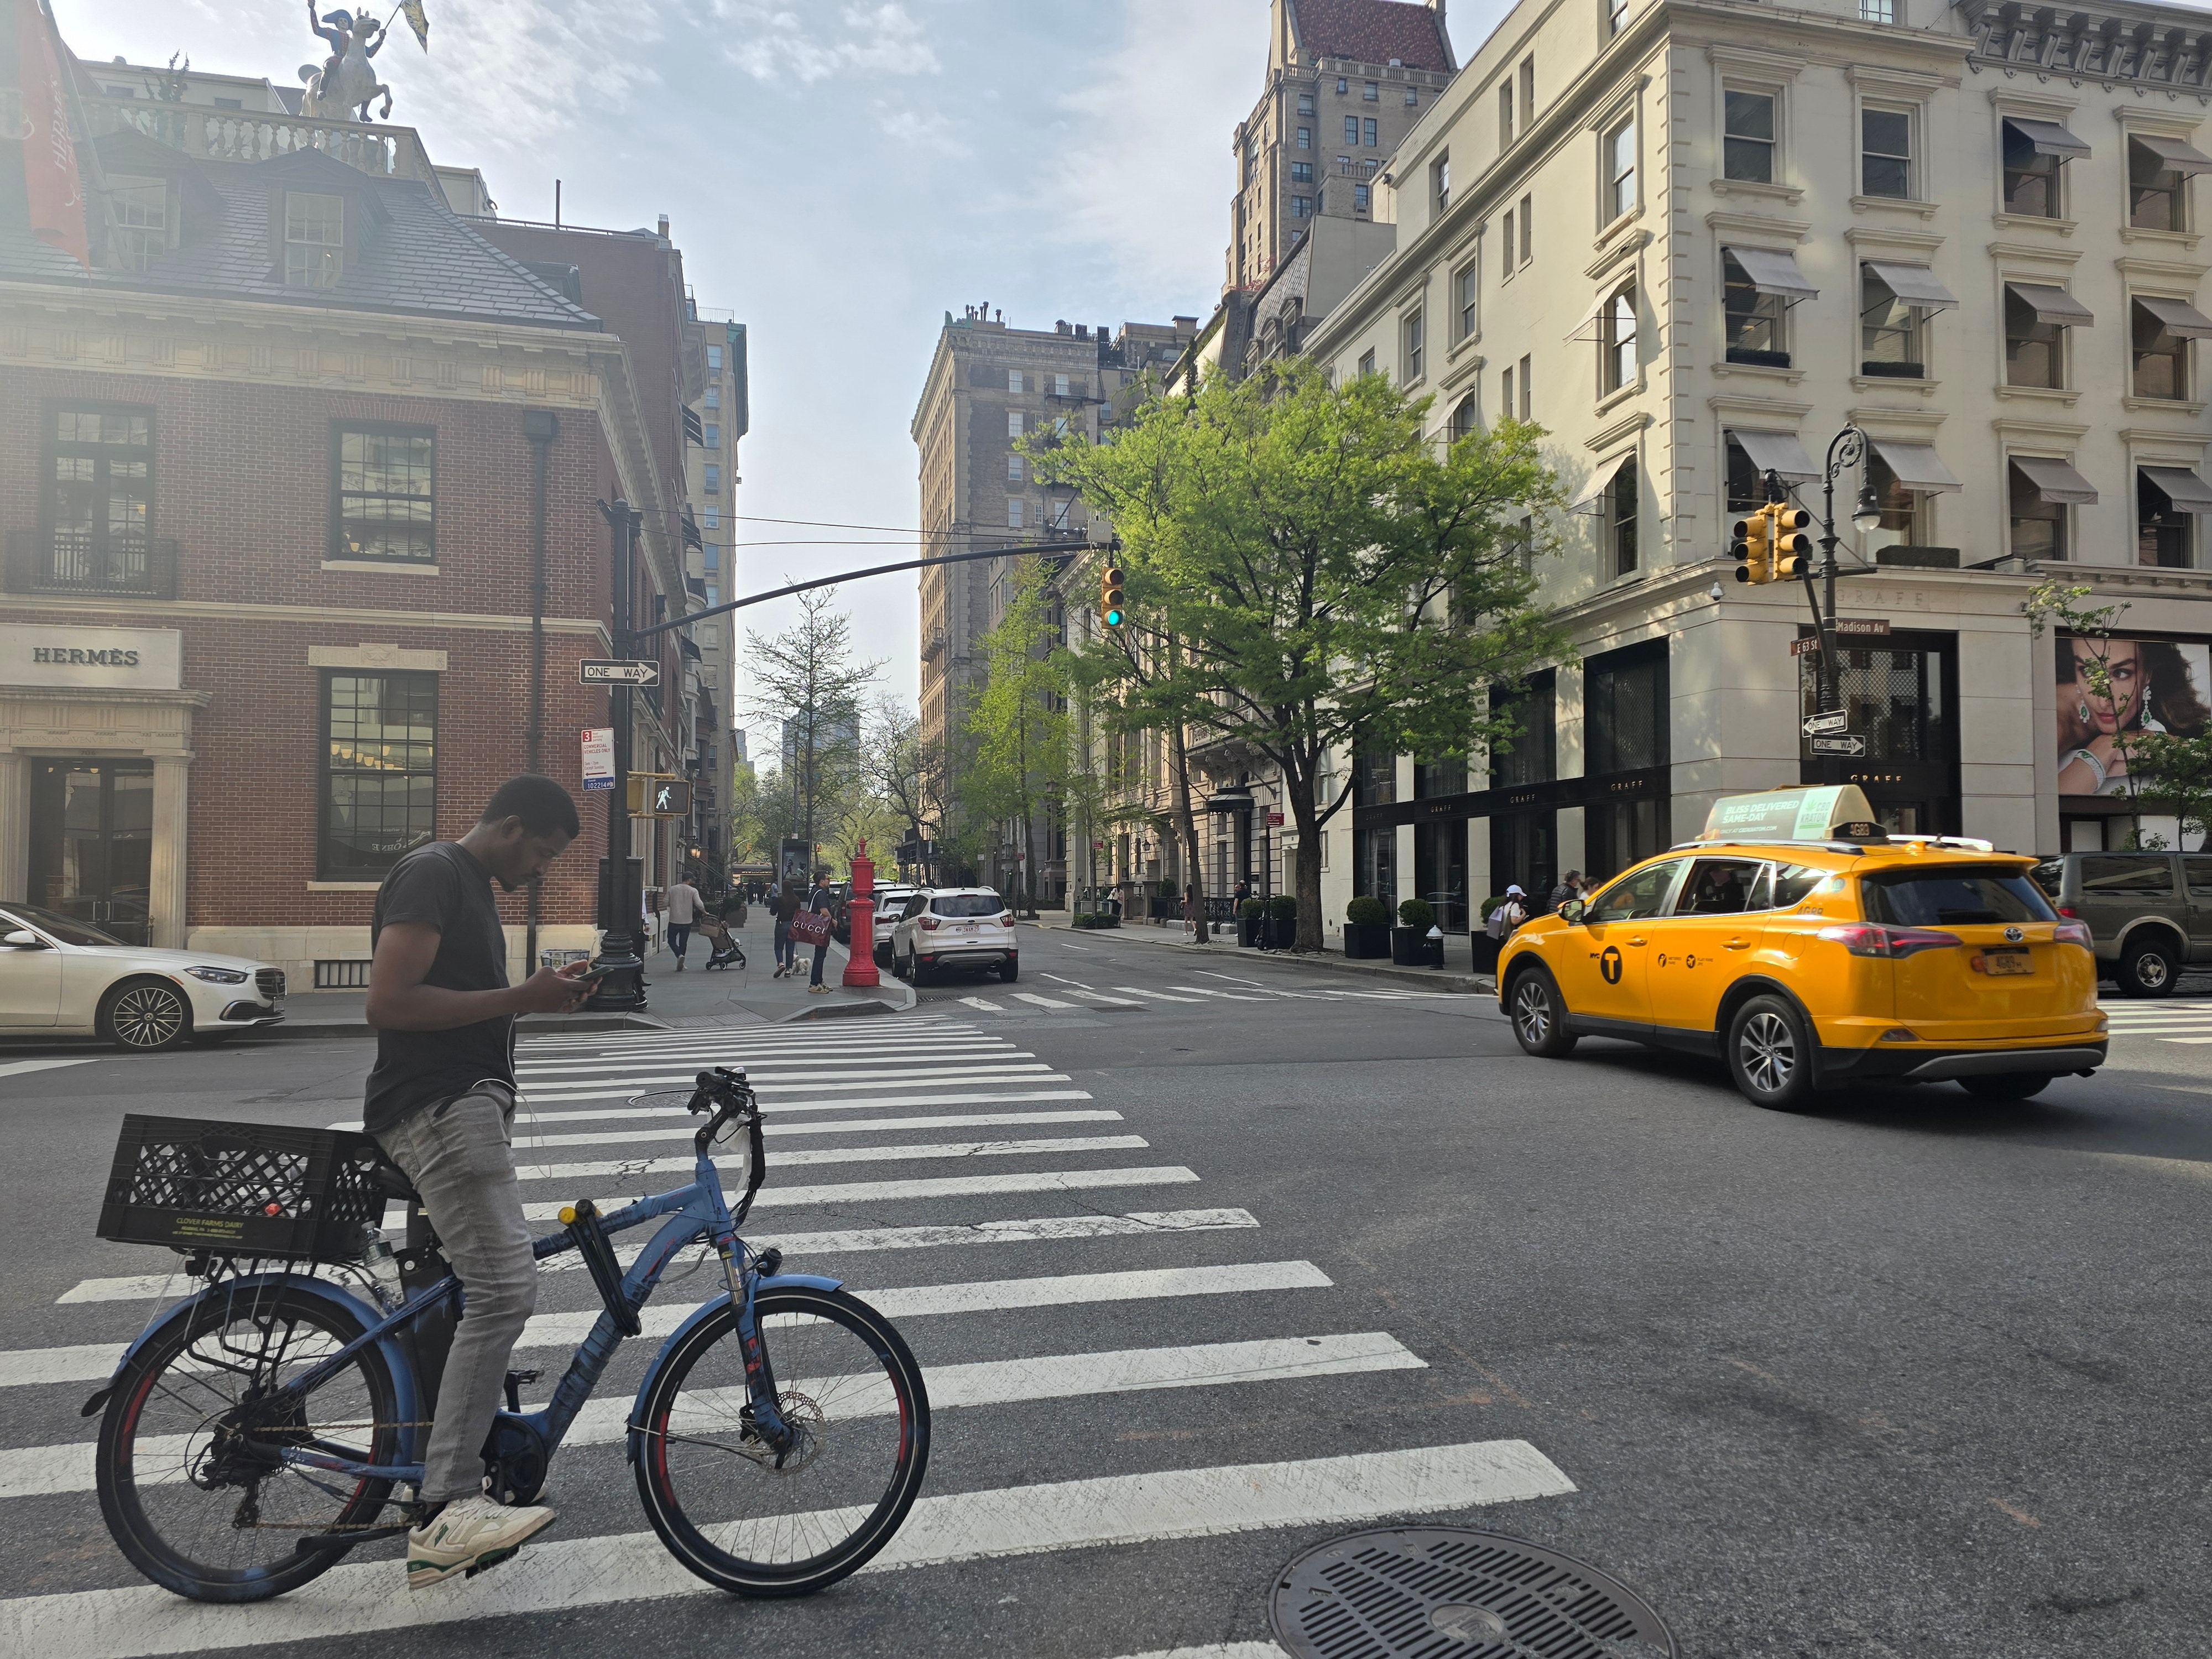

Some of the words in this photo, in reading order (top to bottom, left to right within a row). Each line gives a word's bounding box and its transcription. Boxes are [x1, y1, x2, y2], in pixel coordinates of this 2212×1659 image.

[1835, 589, 1923, 606] GRAFF
[1838, 622, 1871, 633] Madison
[1874, 623, 1884, 633] Av
[1797, 644, 1801, 653] E
[1803, 641, 1809, 652] 63
[1811, 639, 1817, 650] St
[33, 647, 139, 665] HERMÈS
[588, 667, 610, 677] ONE
[623, 668, 648, 678] WAY
[1808, 721, 1821, 730] ONE
[1828, 717, 1842, 727] WAY
[585, 732, 590, 741] 3
[1816, 740, 1832, 748] ONE
[1840, 741, 1858, 750] WAY
[1850, 775, 1902, 783] GRAFF
[1610, 780, 1642, 791] GRAFF
[1510, 794, 1536, 804] GRAFF
[1431, 805, 1452, 813] GRAFF
[1725, 804, 1749, 815] BLISS
[1750, 800, 1800, 812] DELIVERED
[1816, 802, 1831, 812] CBD
[1722, 812, 1767, 824] SAME-DAY
[793, 920, 825, 934] GUCCI
[1605, 953, 1619, 980] T
[201, 1219, 224, 1227] FARMS
